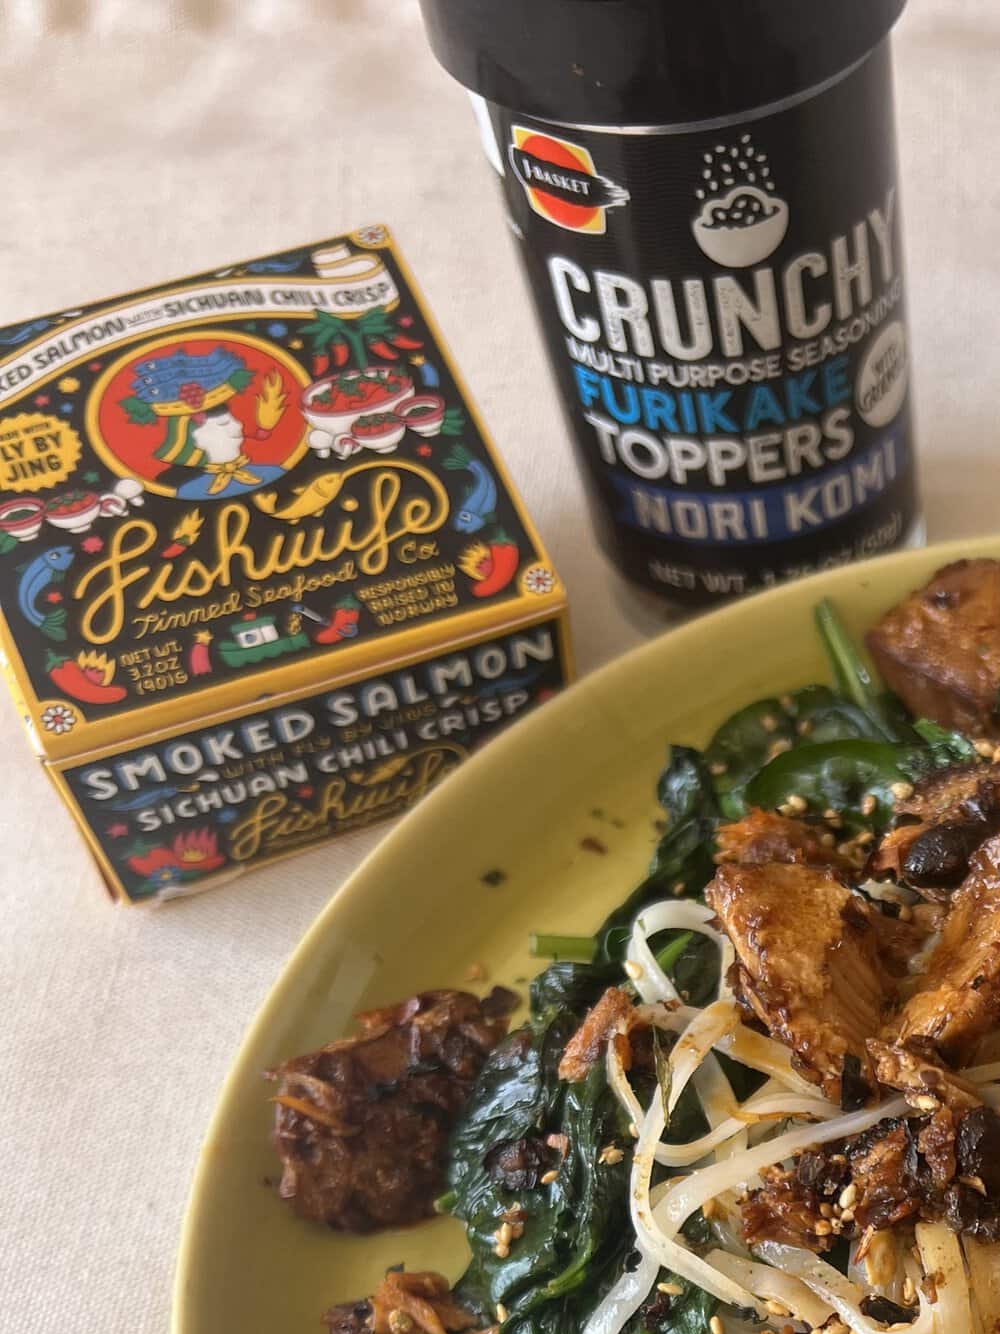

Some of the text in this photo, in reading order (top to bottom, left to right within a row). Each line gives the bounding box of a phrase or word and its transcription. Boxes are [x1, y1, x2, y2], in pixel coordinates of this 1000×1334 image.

[549, 187, 898, 360] CRUNCHY
[32, 316, 126, 370] SALMON
[164, 288, 265, 318] SICHUAN
[269, 289, 327, 306] CHILI
[332, 282, 390, 307] CRISP
[566, 335, 644, 383] MULTI
[645, 354, 781, 389] PURPOSE
[571, 355, 851, 435] FURIKAKE
[7, 454, 62, 482] JING
[33, 431, 61, 452] BY
[585, 407, 856, 487] TOPPERS
[632, 439, 898, 541] NORI KOMI
[133, 595, 242, 639] Tinned
[247, 560, 358, 607] Seafood
[120, 648, 151, 667] NET
[88, 631, 555, 801] SMOKED SALMON
[137, 760, 309, 832] SICHUAN
[317, 728, 409, 773] CHILI
[419, 688, 530, 740] CRISP
